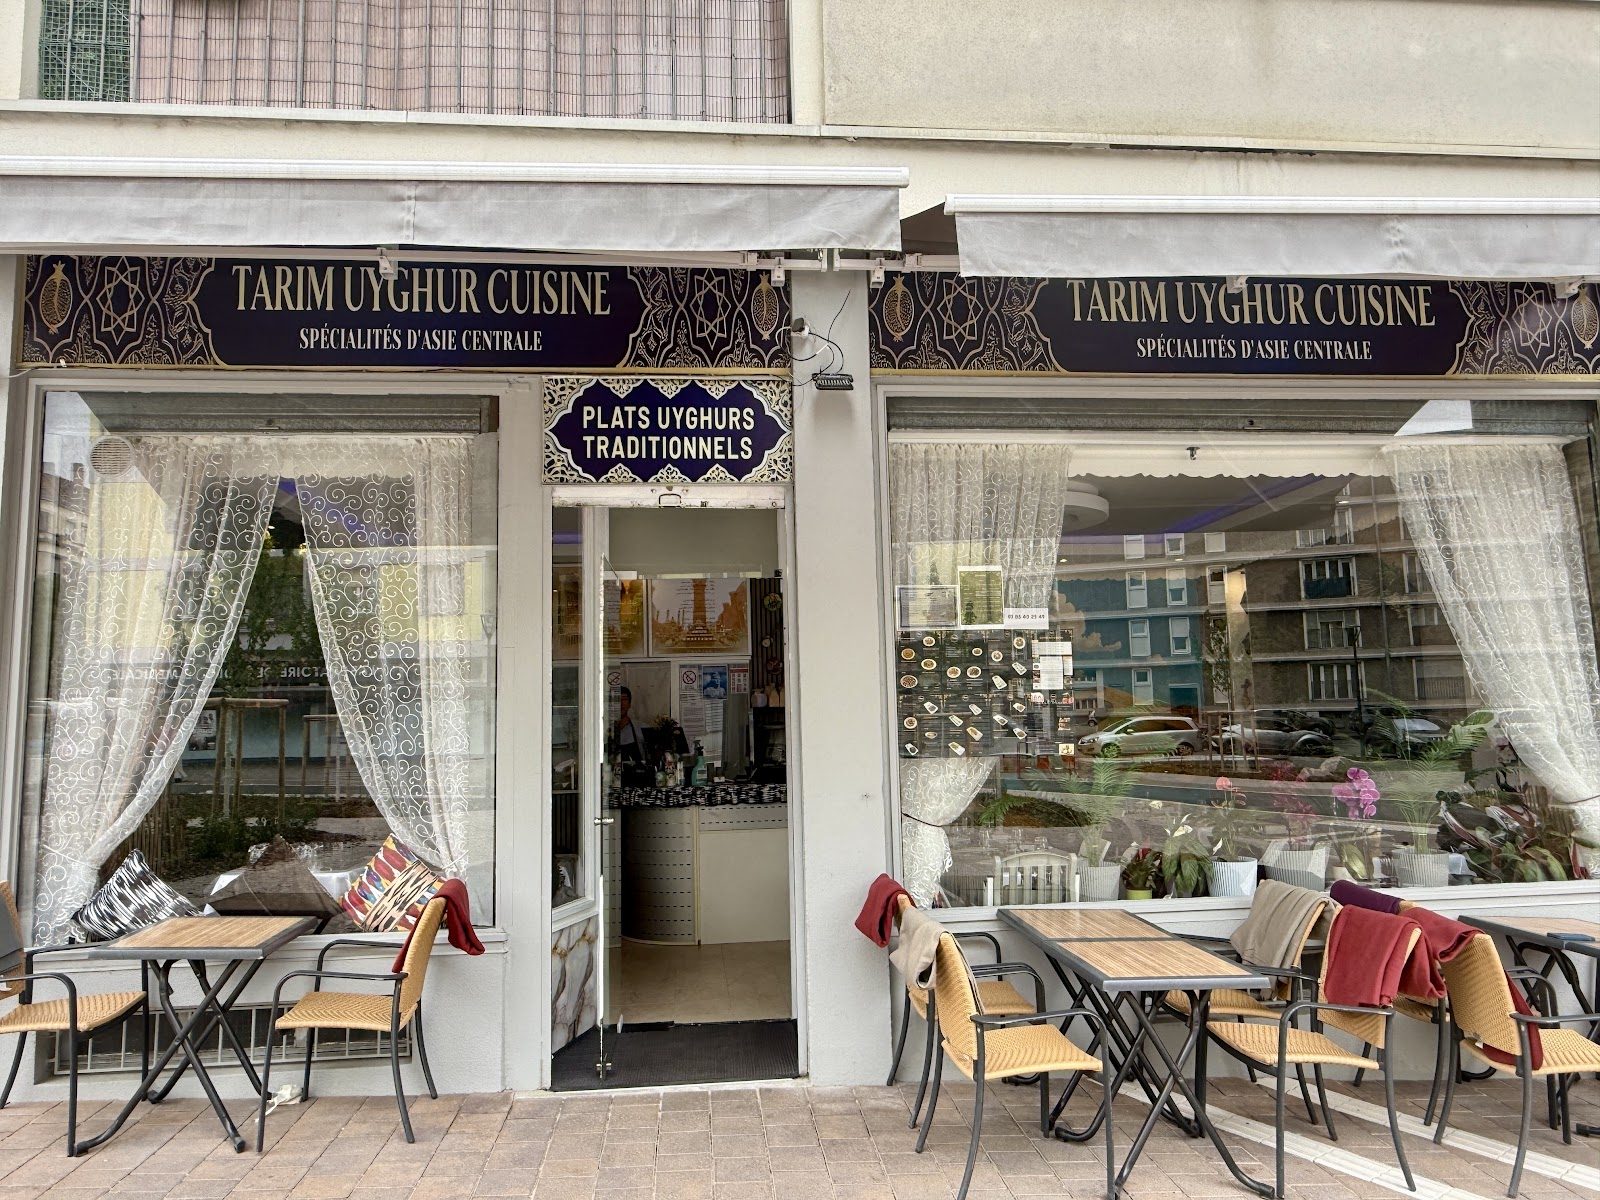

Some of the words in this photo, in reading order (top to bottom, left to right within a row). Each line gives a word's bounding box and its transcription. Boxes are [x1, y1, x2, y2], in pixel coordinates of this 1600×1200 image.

[231, 265, 334, 312] TARIM
[343, 266, 481, 314] UYGHUR
[487, 268, 611, 316] CUISINE
[1065, 279, 1169, 323] TARIM
[1174, 281, 1310, 325] UYGHUR
[1314, 283, 1436, 327] CUISINE
[299, 323, 401, 351] SPÉCIALITÉS
[407, 328, 457, 351] D'ASIE
[461, 329, 543, 352] CENTRALE
[1136, 334, 1237, 360] SPÉCIALITÉS
[1241, 338, 1290, 360] D'ASIE
[1294, 339, 1373, 361] CENTRALE
[582, 405, 651, 430] PLATS
[657, 406, 755, 431] UYGHURS
[582, 435, 753, 460] TRADITIONNELS
